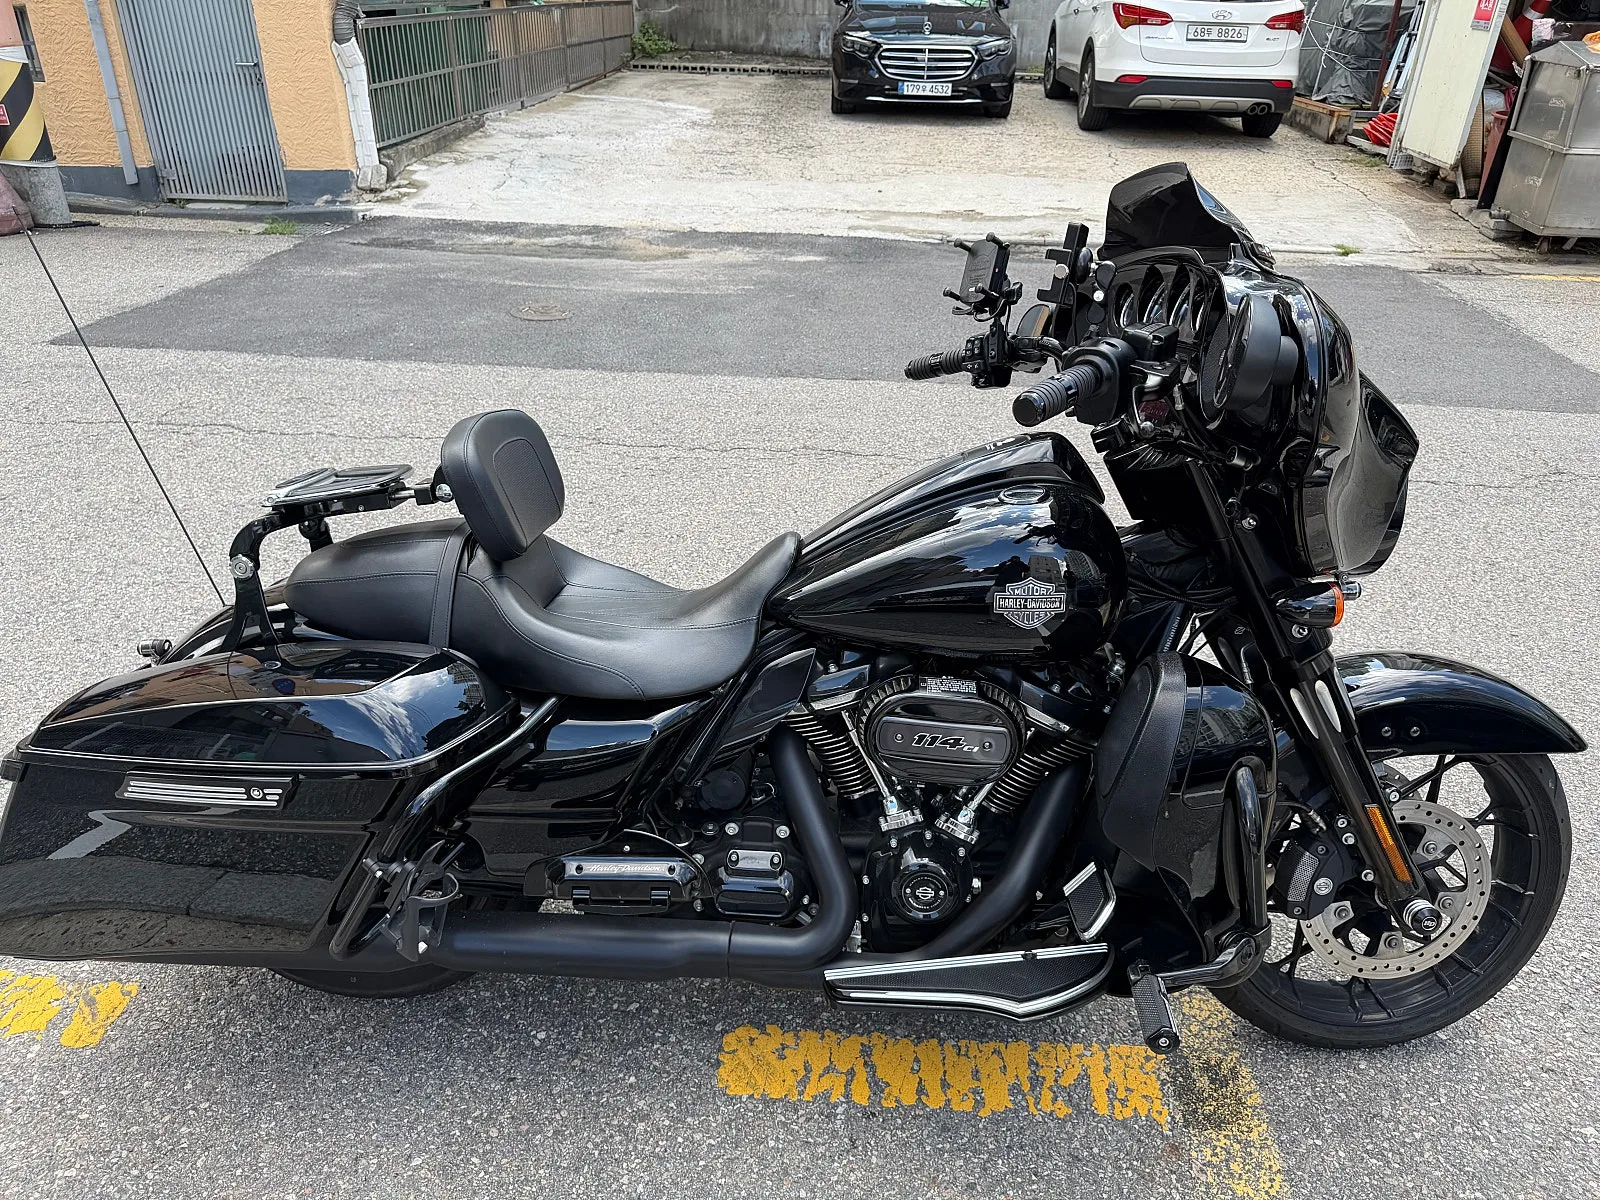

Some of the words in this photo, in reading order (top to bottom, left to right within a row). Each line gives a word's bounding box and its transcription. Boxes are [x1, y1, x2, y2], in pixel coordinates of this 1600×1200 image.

[1193, 27, 1213, 38] 68두
[1217, 28, 1243, 39] 8826
[905, 83, 927, 94] 179우
[928, 84, 950, 95] 4532
[1014, 584, 1047, 596] MOTOR
[999, 597, 1061, 609] HARLEY-DAVIDSON
[1013, 611, 1046, 625] CYCLES
